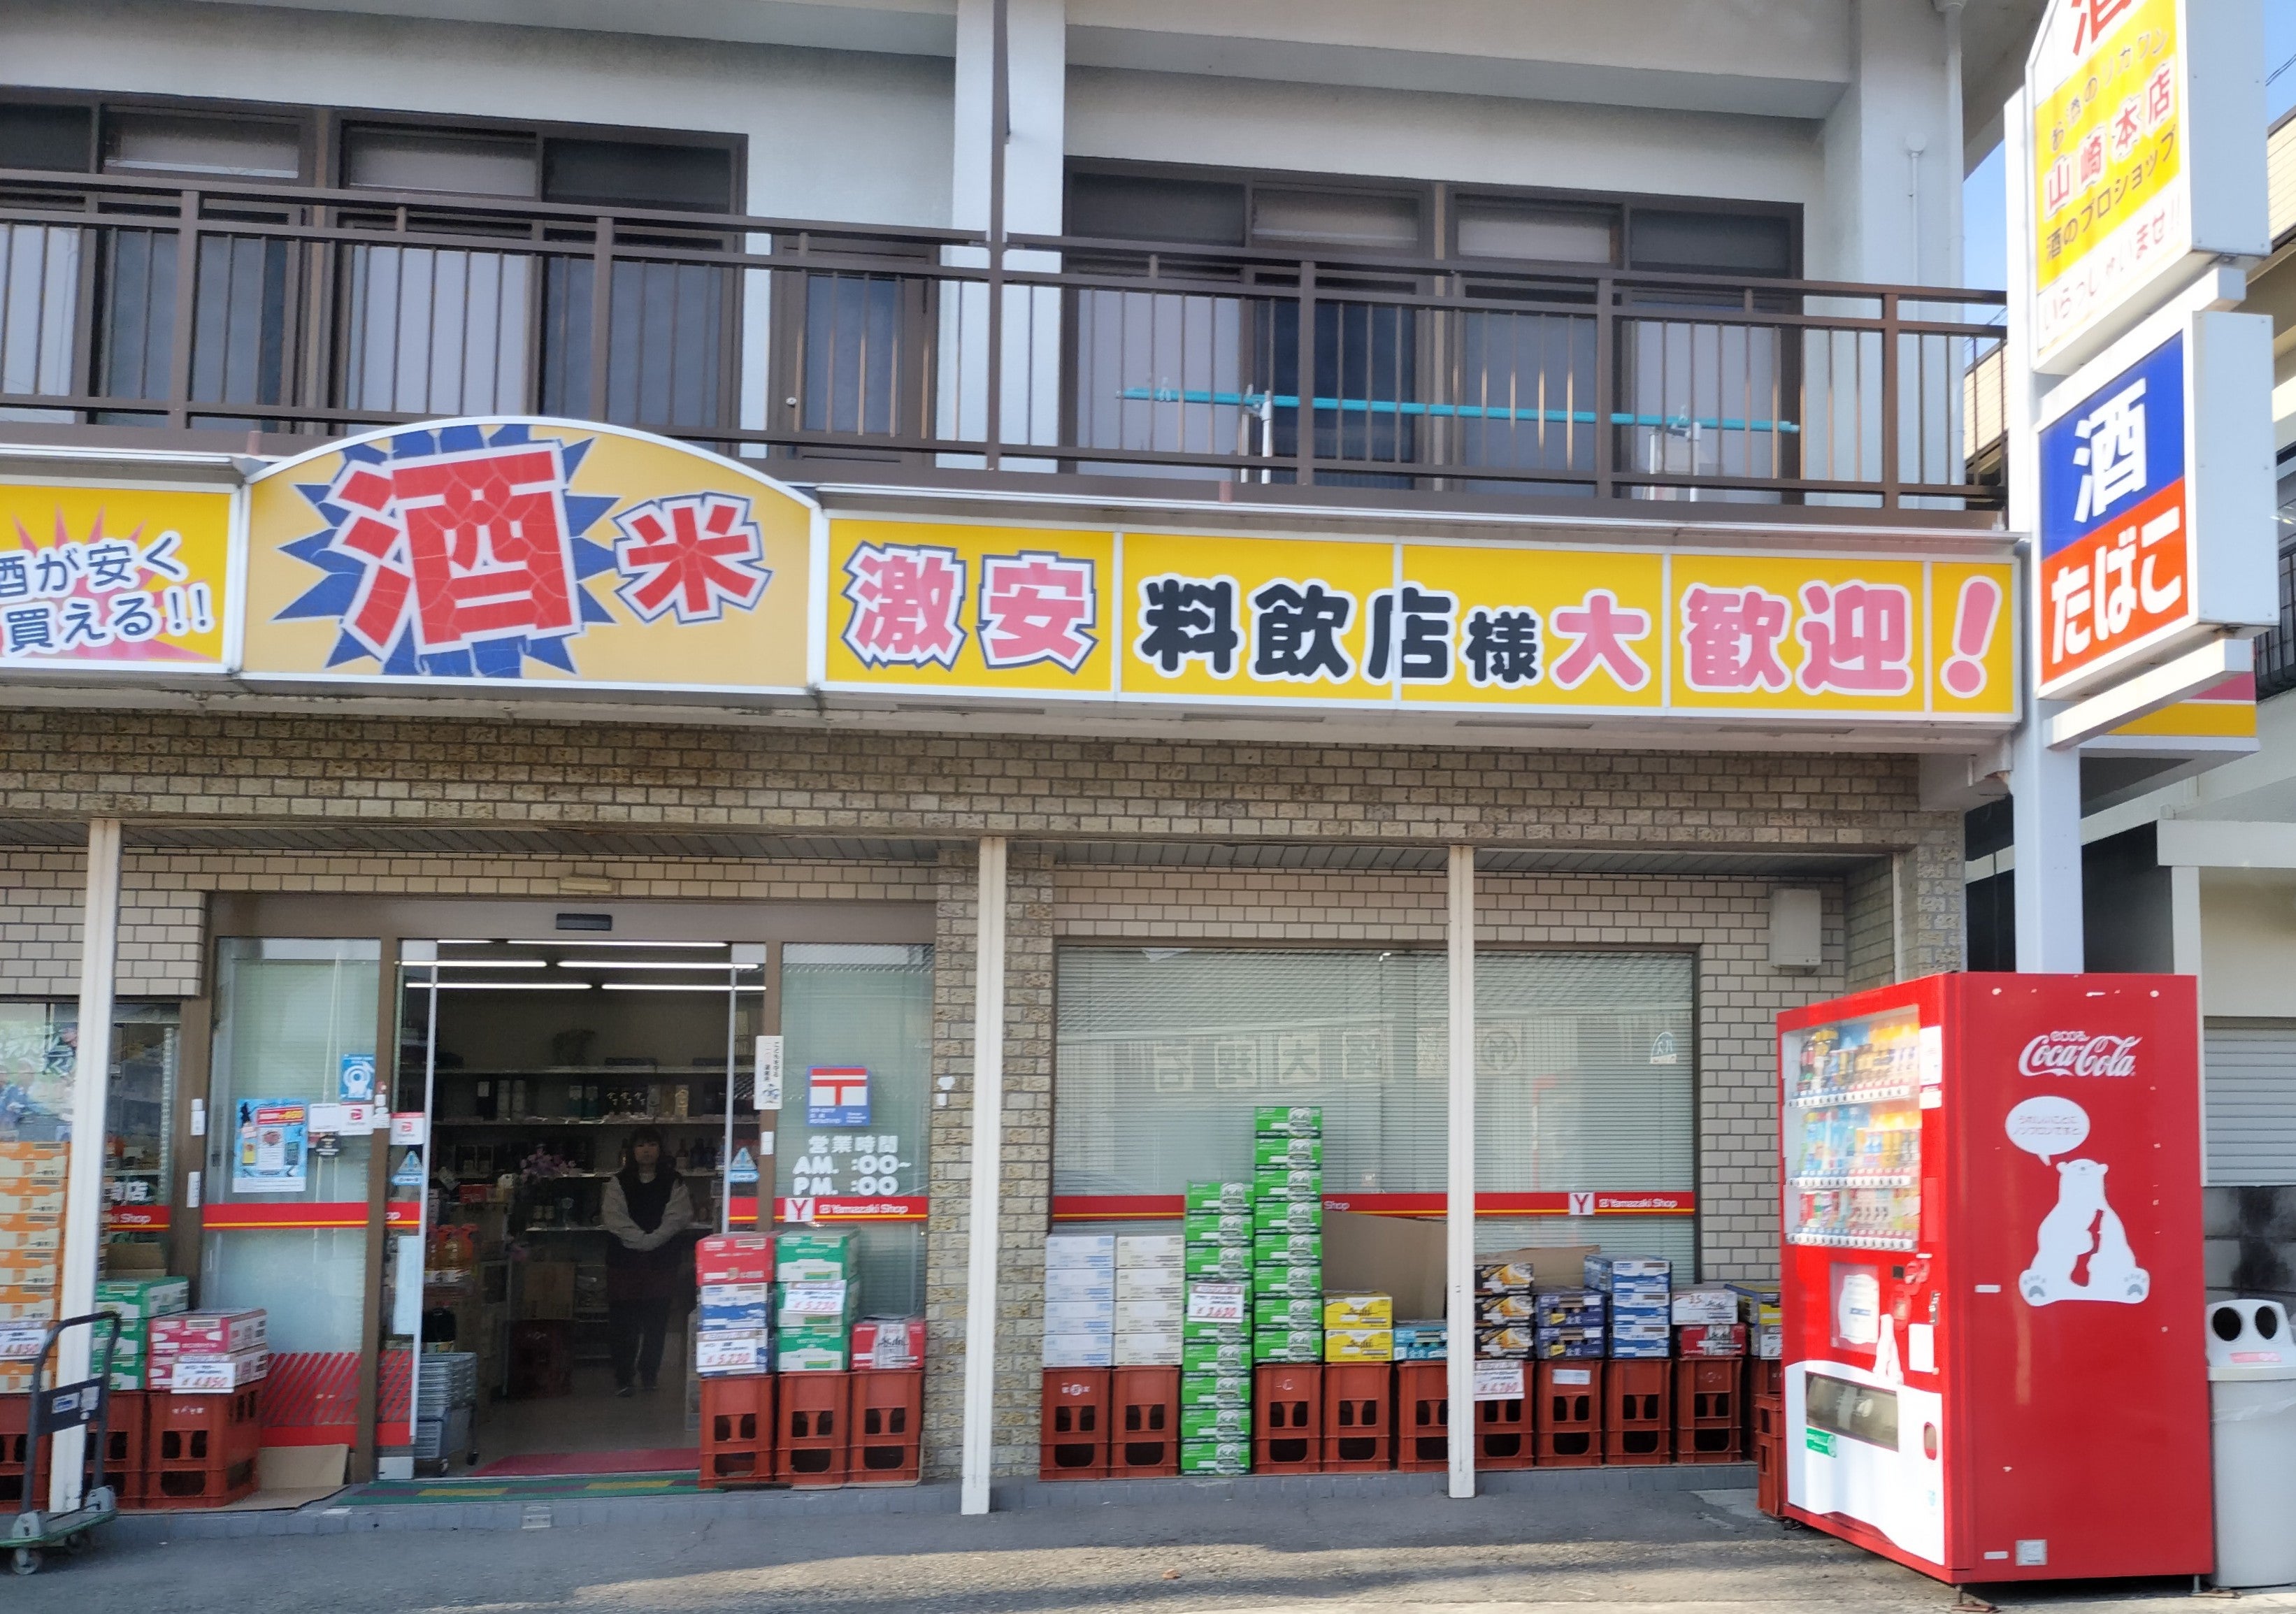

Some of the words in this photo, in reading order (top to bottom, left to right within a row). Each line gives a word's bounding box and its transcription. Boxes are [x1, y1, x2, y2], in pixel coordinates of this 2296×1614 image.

[2048, 67, 2171, 210] 山崎本店
[2072, 376, 2148, 524] 酒
[334, 444, 577, 656] 酒
[620, 498, 765, 619] 米
[2051, 505, 2182, 665] たばこ
[6, 586, 211, 652] 買える!!
[848, 548, 1093, 668] 激安
[2018, 1035, 2143, 1077] Coca-Cola
[808, 1135, 898, 1154] 営業時間
[790, 1199, 811, 1220] Y
[1574, 1193, 1590, 1214] Y
